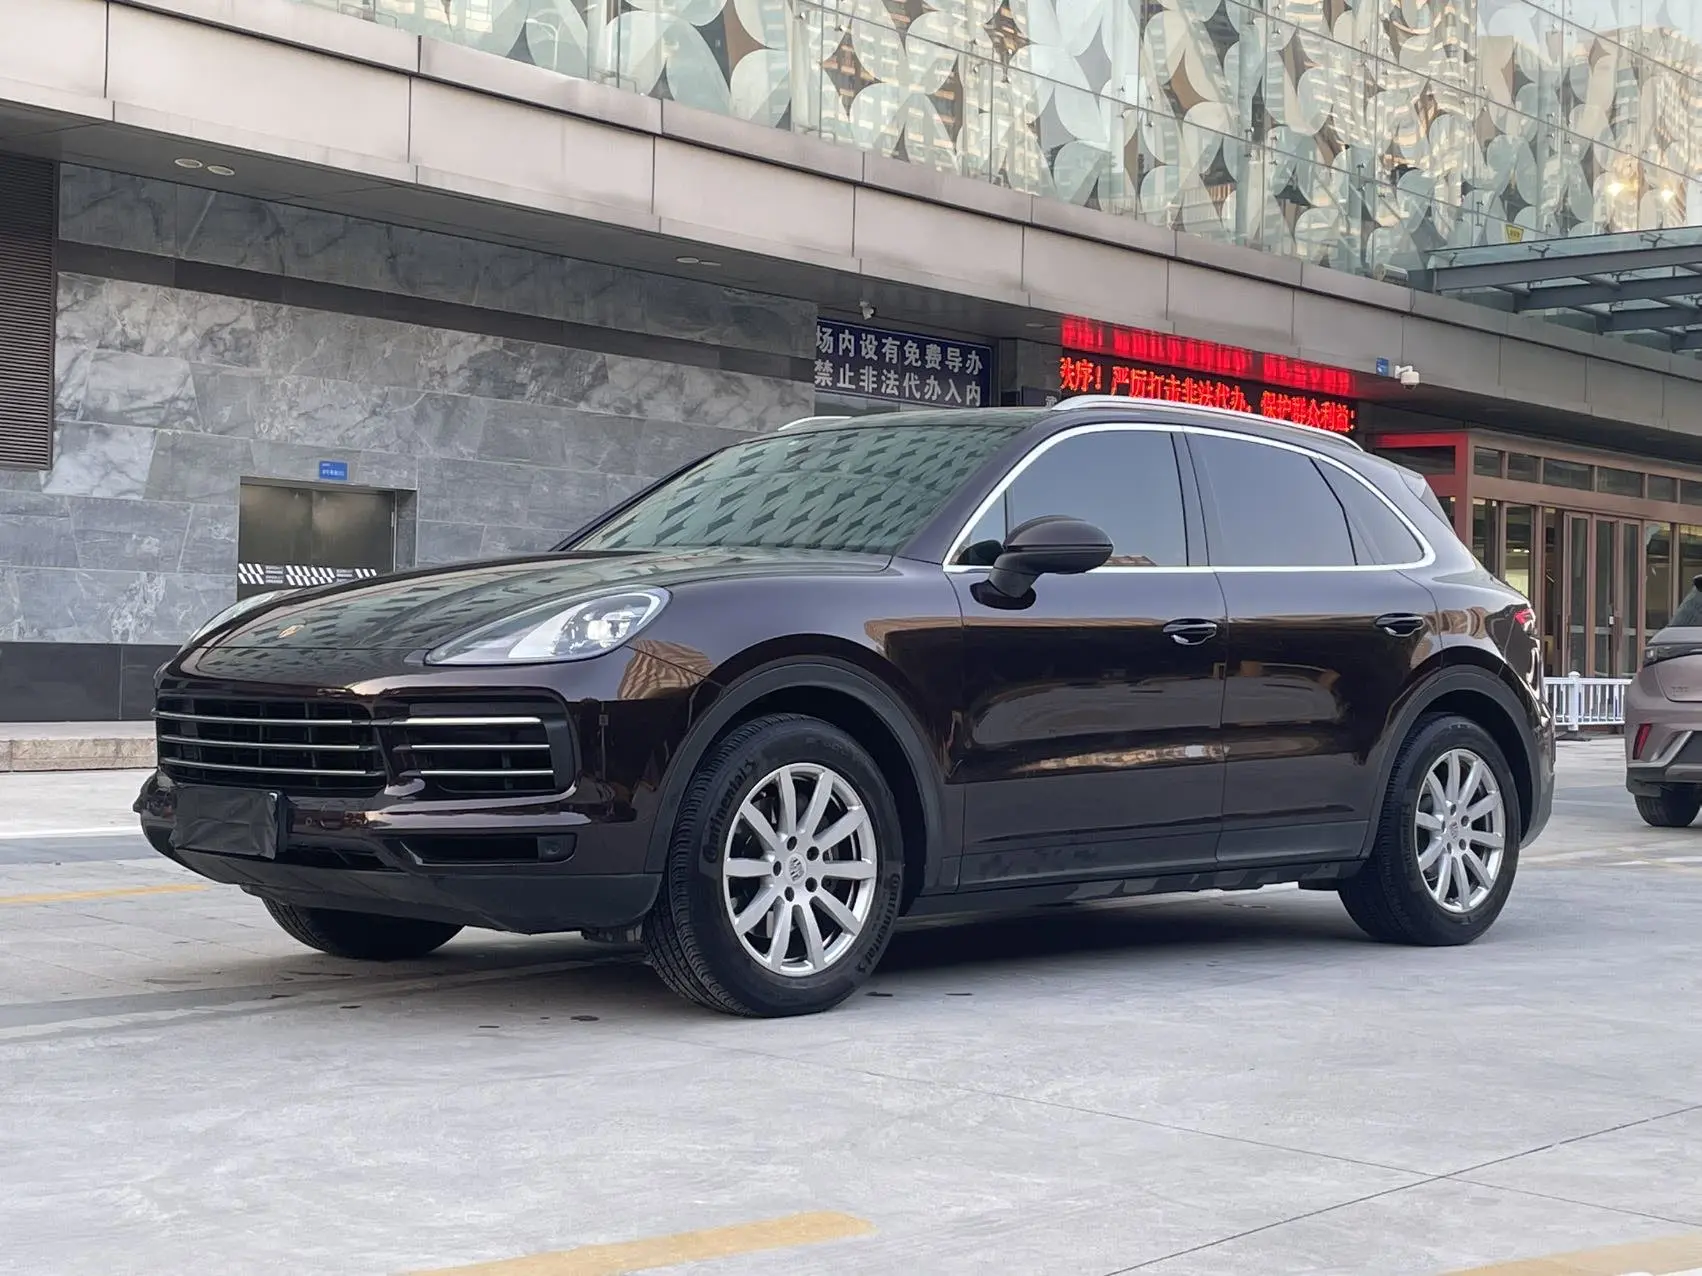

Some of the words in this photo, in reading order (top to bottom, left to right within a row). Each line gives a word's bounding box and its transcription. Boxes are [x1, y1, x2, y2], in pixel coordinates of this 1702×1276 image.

[816, 325, 983, 375] 场内设有免费导办
[814, 359, 981, 407] 禁止非法代办入内
